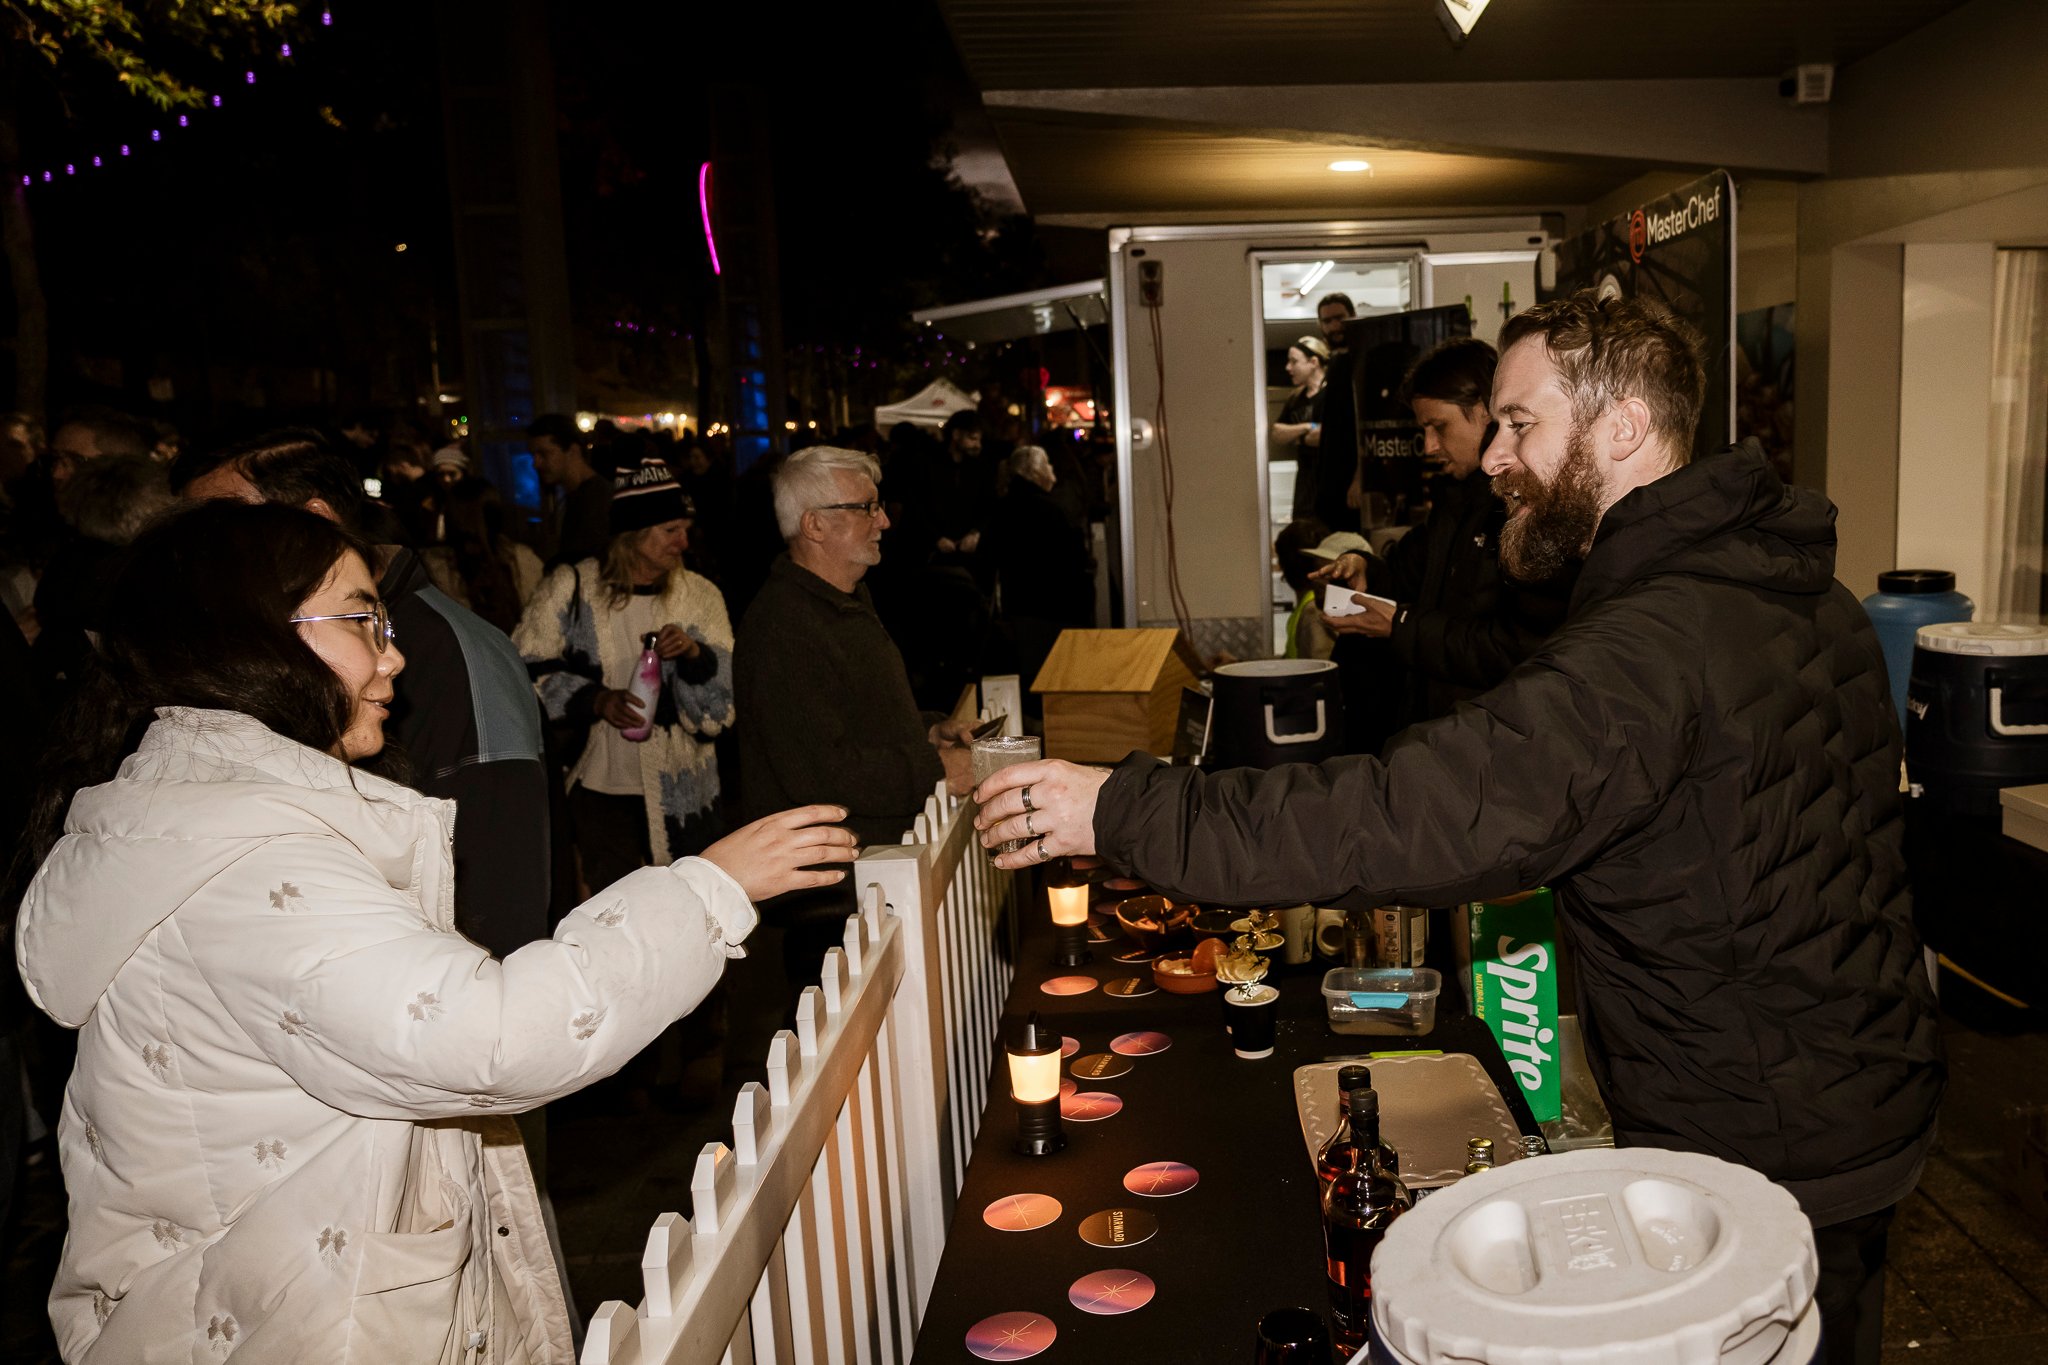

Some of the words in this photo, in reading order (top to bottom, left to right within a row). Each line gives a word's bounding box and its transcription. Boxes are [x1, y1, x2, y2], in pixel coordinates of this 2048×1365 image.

[1646, 186, 1721, 246] MasterChef
[1364, 432, 1425, 457] MasterC
[1475, 973, 1484, 1003] NATURAL
[1486, 935, 1554, 1091] Sprite
[1112, 1211, 1125, 1242] STARWARD
